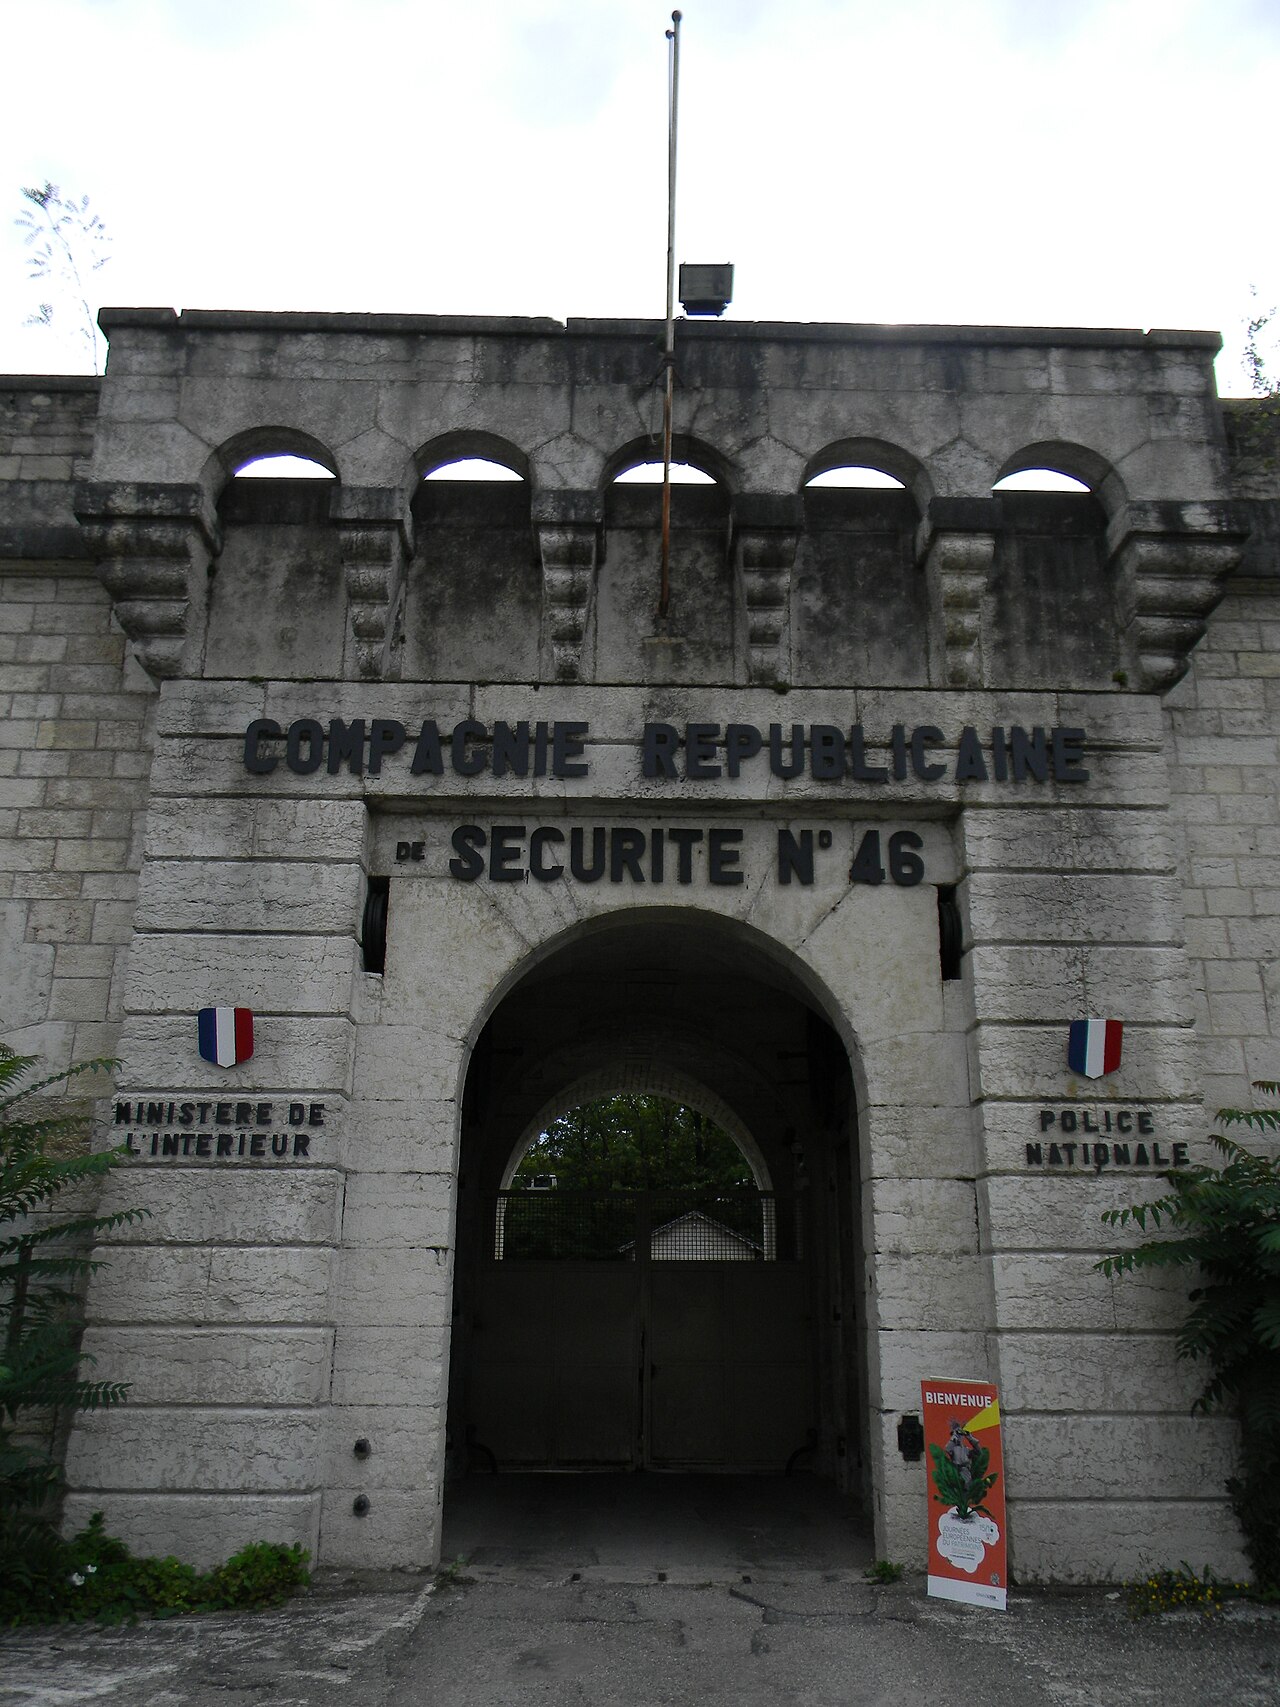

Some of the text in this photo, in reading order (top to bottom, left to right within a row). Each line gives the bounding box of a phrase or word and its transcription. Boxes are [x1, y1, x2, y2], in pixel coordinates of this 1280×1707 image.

[243, 718, 1090, 782] COMPAGNIE REPUBLICAINE
[396, 841, 426, 862] DE
[449, 824, 744, 884] SECURITE
[850, 829, 925, 886] 46
[115, 1101, 325, 1126] MINISTERE DE
[1040, 1110, 1154, 1133] POLICE
[126, 1132, 311, 1157] L'INTERIEUR
[1026, 1142, 1190, 1166] NATIONALE
[926, 1391, 992, 1408] BIENVENUE
